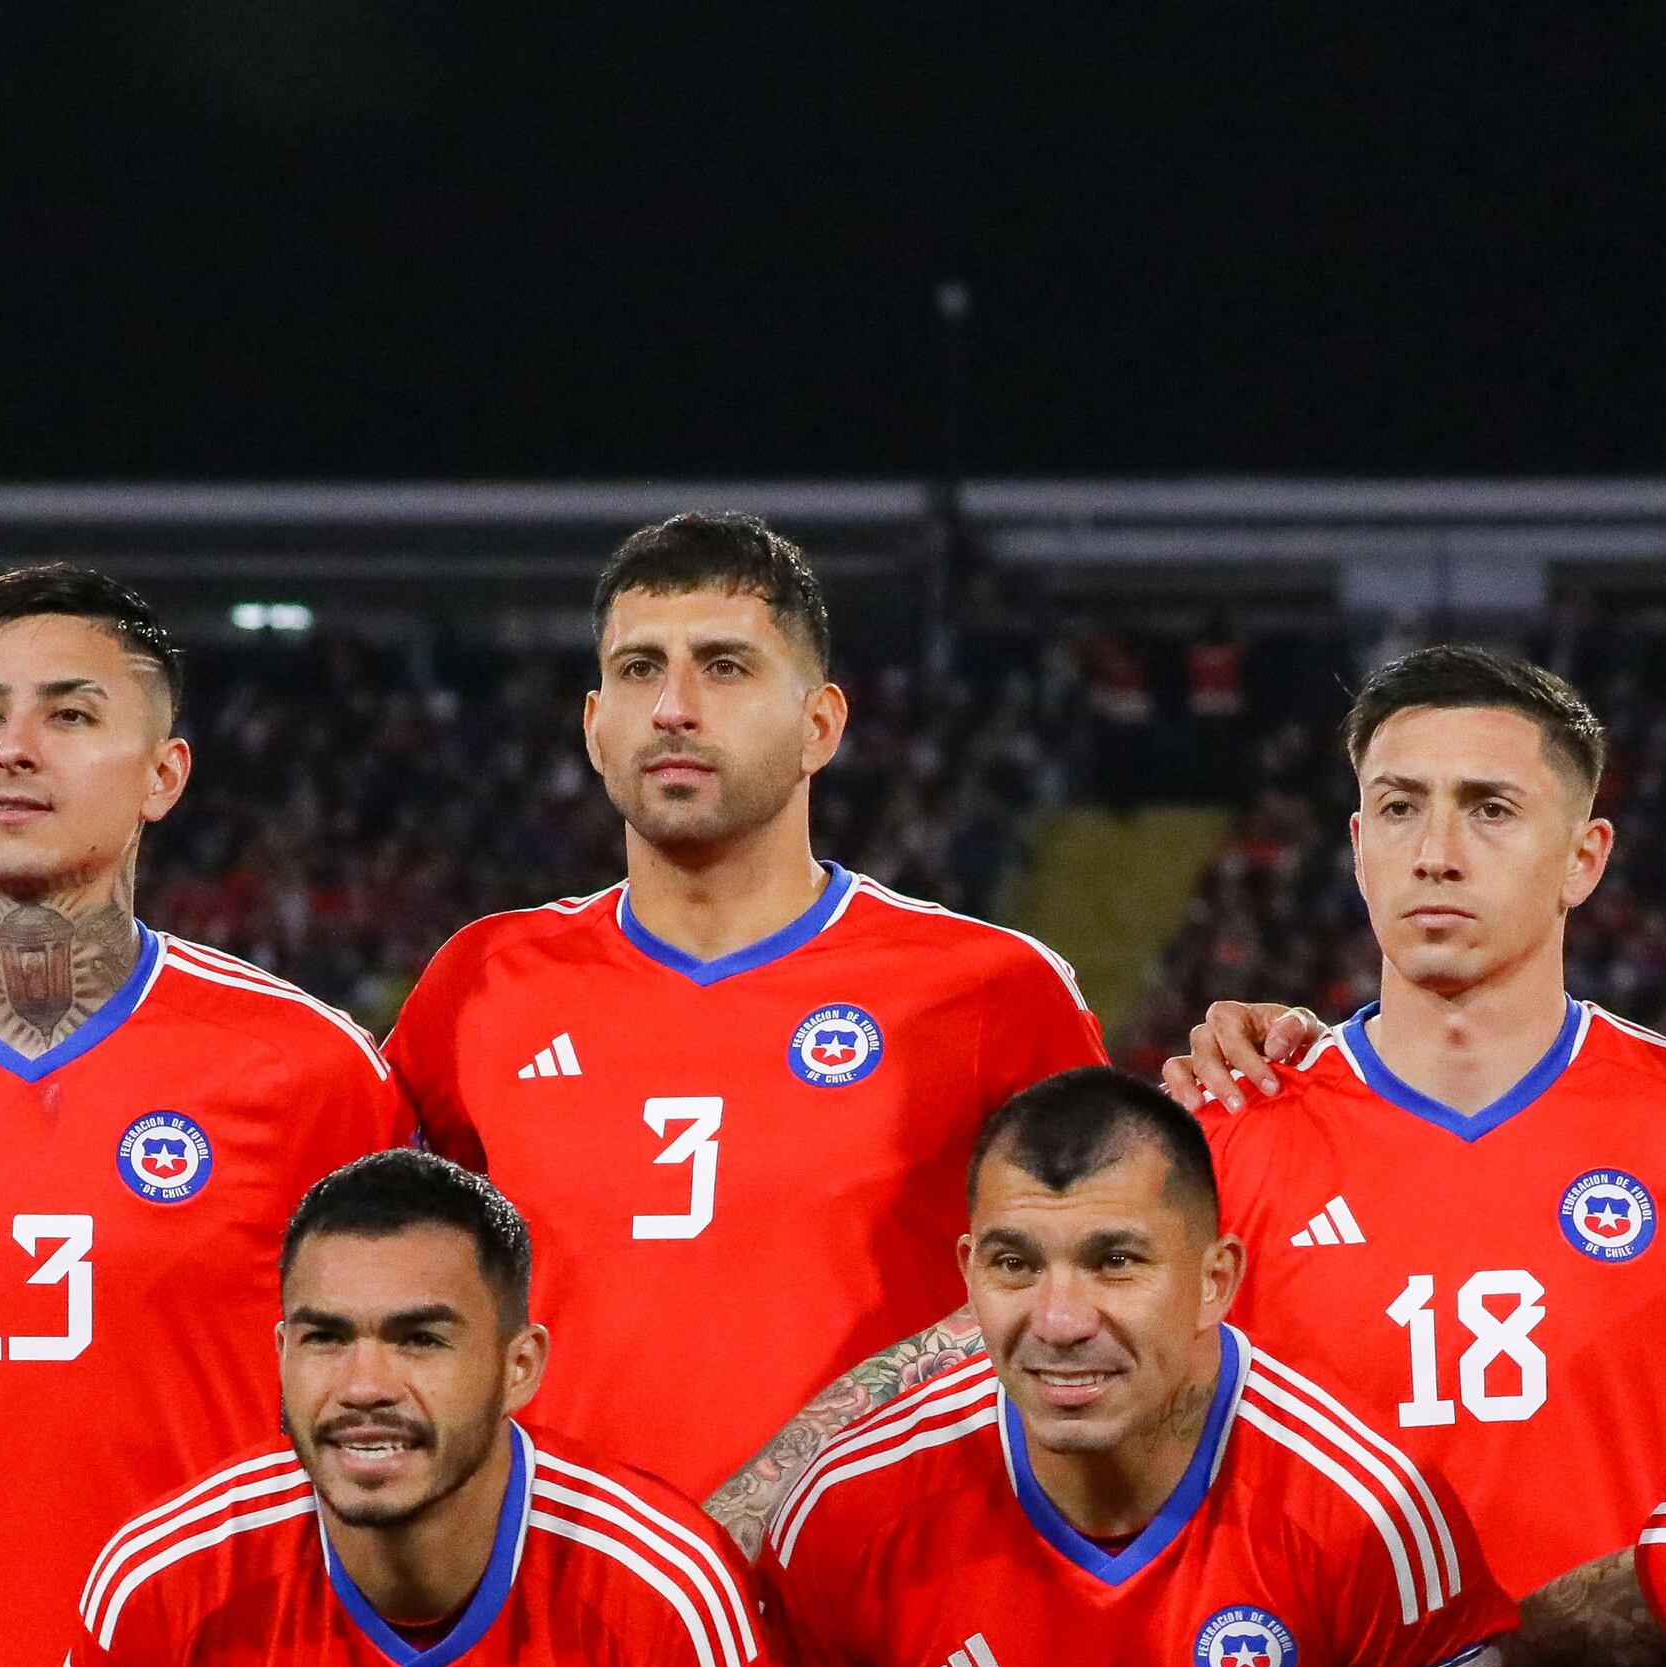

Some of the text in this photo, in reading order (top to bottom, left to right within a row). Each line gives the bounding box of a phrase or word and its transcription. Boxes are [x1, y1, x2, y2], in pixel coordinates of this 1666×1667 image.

[792, 1009, 880, 1052] FEDERACION DE FUTBOL
[806, 1071, 854, 1083] DE CHILE
[119, 1116, 209, 1161] FEDERACION DE FUTBOL
[631, 1096, 724, 1240] 3
[142, 1184, 190, 1199] DE CHILE
[1561, 1174, 1653, 1221] FEDERACION DE FUTBOL
[1585, 1242, 1633, 1258] DE CHILE
[1386, 1269, 1547, 1428] 18
[1197, 1610, 1293, 1657] FEDERACION DE FUTBOL
